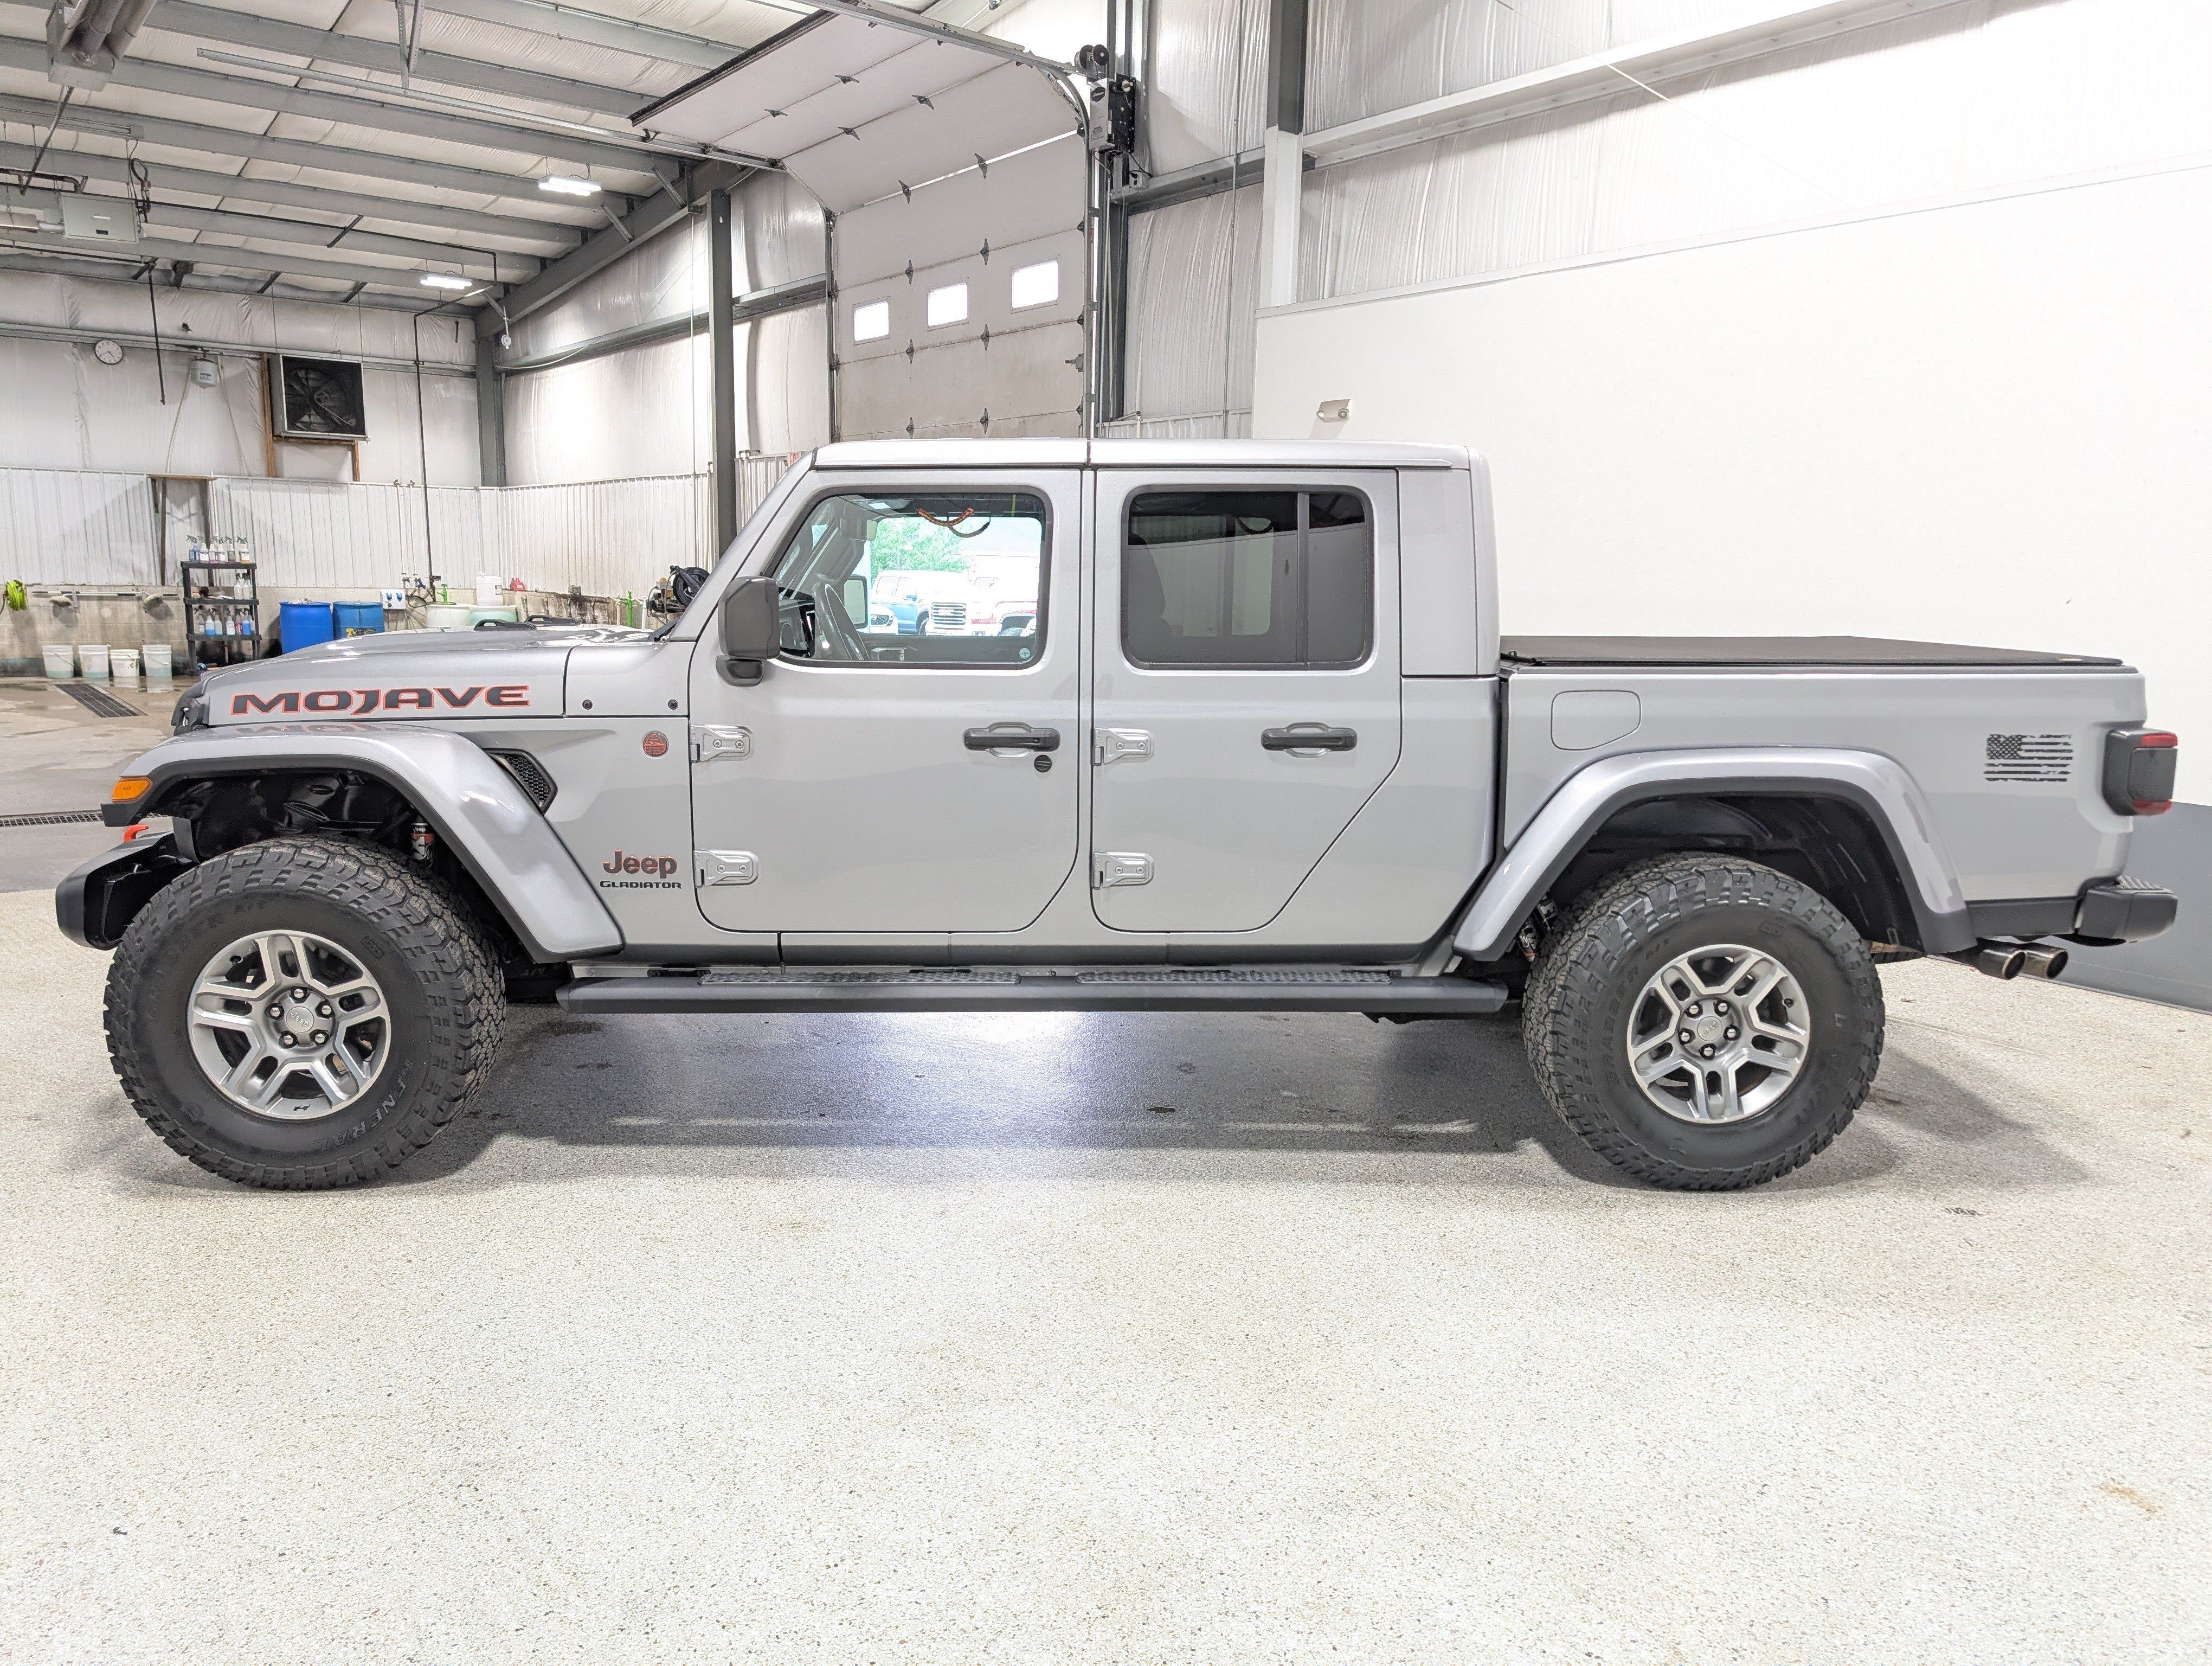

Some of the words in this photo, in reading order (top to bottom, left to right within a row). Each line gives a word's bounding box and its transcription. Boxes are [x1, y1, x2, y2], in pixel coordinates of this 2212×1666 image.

[231, 685, 530, 715] MOJAVE
[602, 849, 678, 879] Jeep
[600, 880, 682, 889] GLADIATOR
[290, 1012, 310, 1028] Jeep
[312, 1059, 414, 1152] GENERAL
